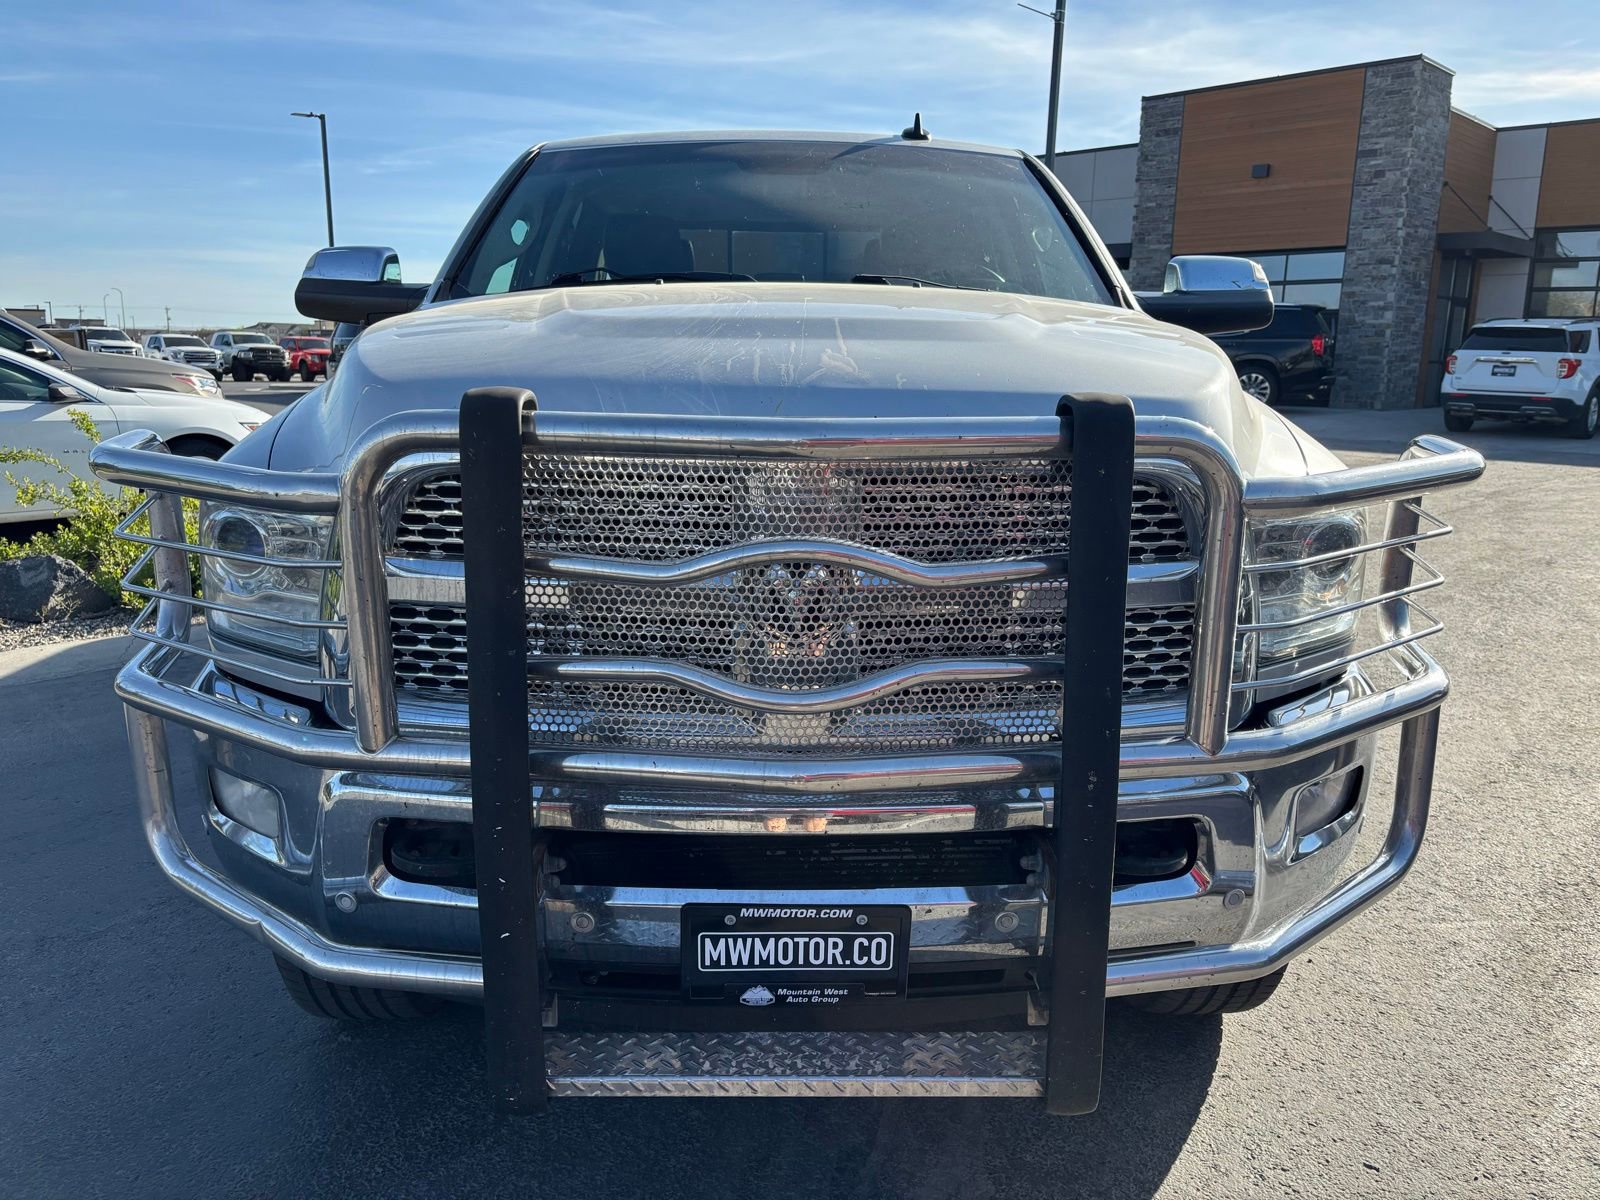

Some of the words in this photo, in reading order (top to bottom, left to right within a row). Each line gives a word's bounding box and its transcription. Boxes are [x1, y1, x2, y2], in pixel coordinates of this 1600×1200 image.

[740, 908, 853, 918] MWMOTOR.COM
[705, 937, 887, 965] MWMOTOR.CO
[777, 988, 820, 996] Mountain
[824, 988, 848, 996] West
[786, 995, 808, 1003] Auto
[811, 995, 839, 1004] Group
